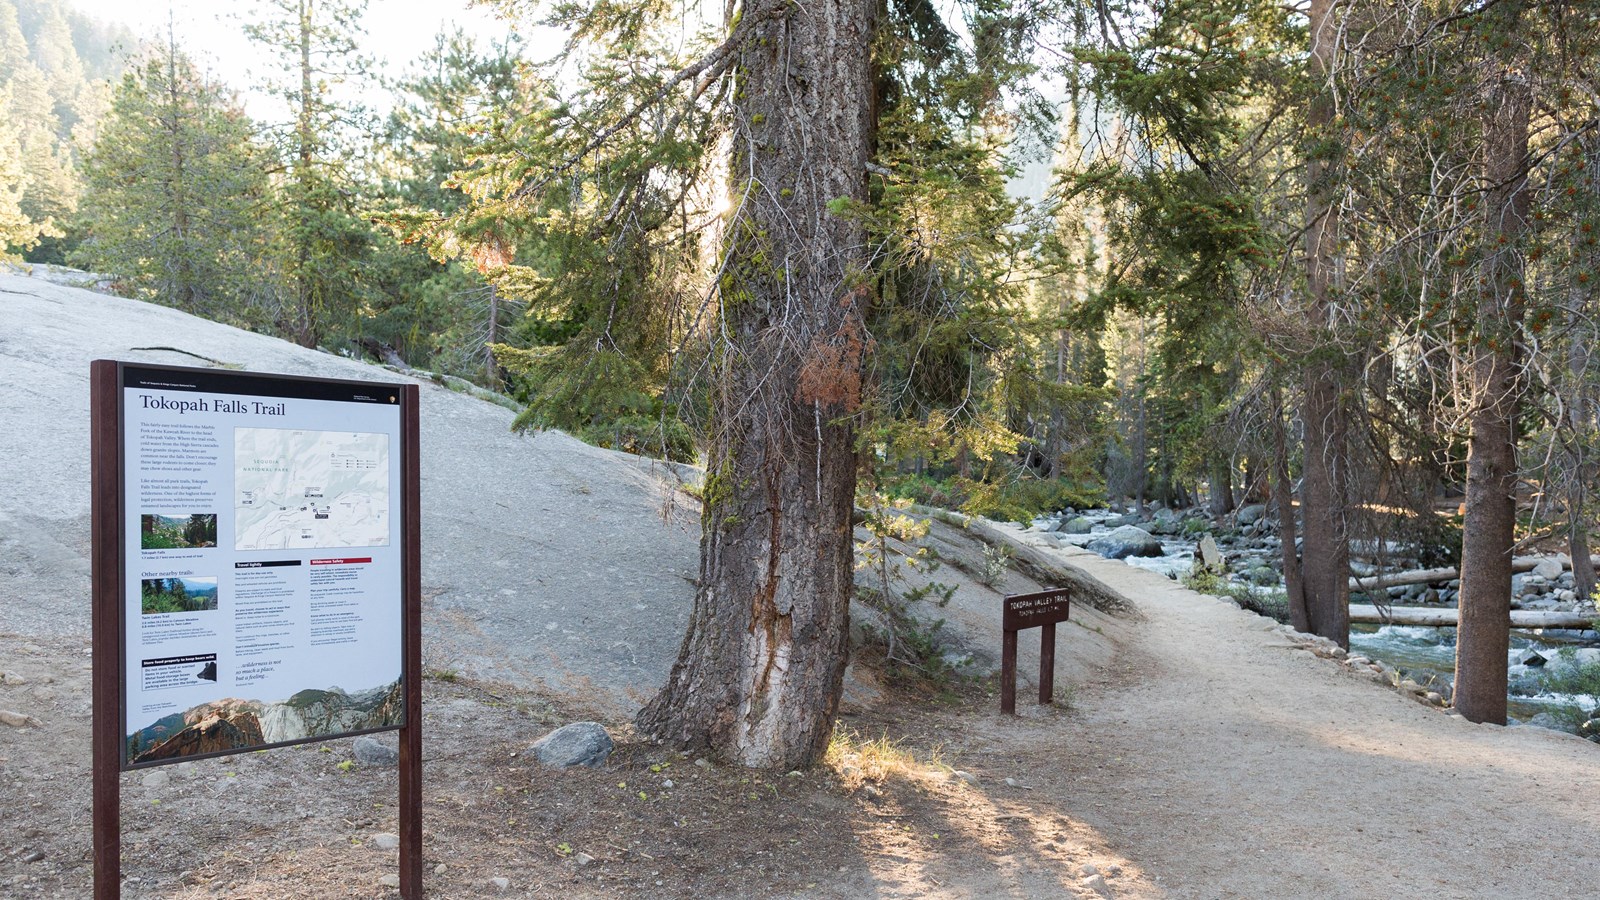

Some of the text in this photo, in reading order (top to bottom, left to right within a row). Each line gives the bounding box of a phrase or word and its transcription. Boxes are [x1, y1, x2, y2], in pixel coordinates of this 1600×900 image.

[140, 395, 285, 415] Tokopah Falls Trail
[1010, 601, 1032, 610] TOKOPAH
[1034, 597, 1052, 606] VALLEY
